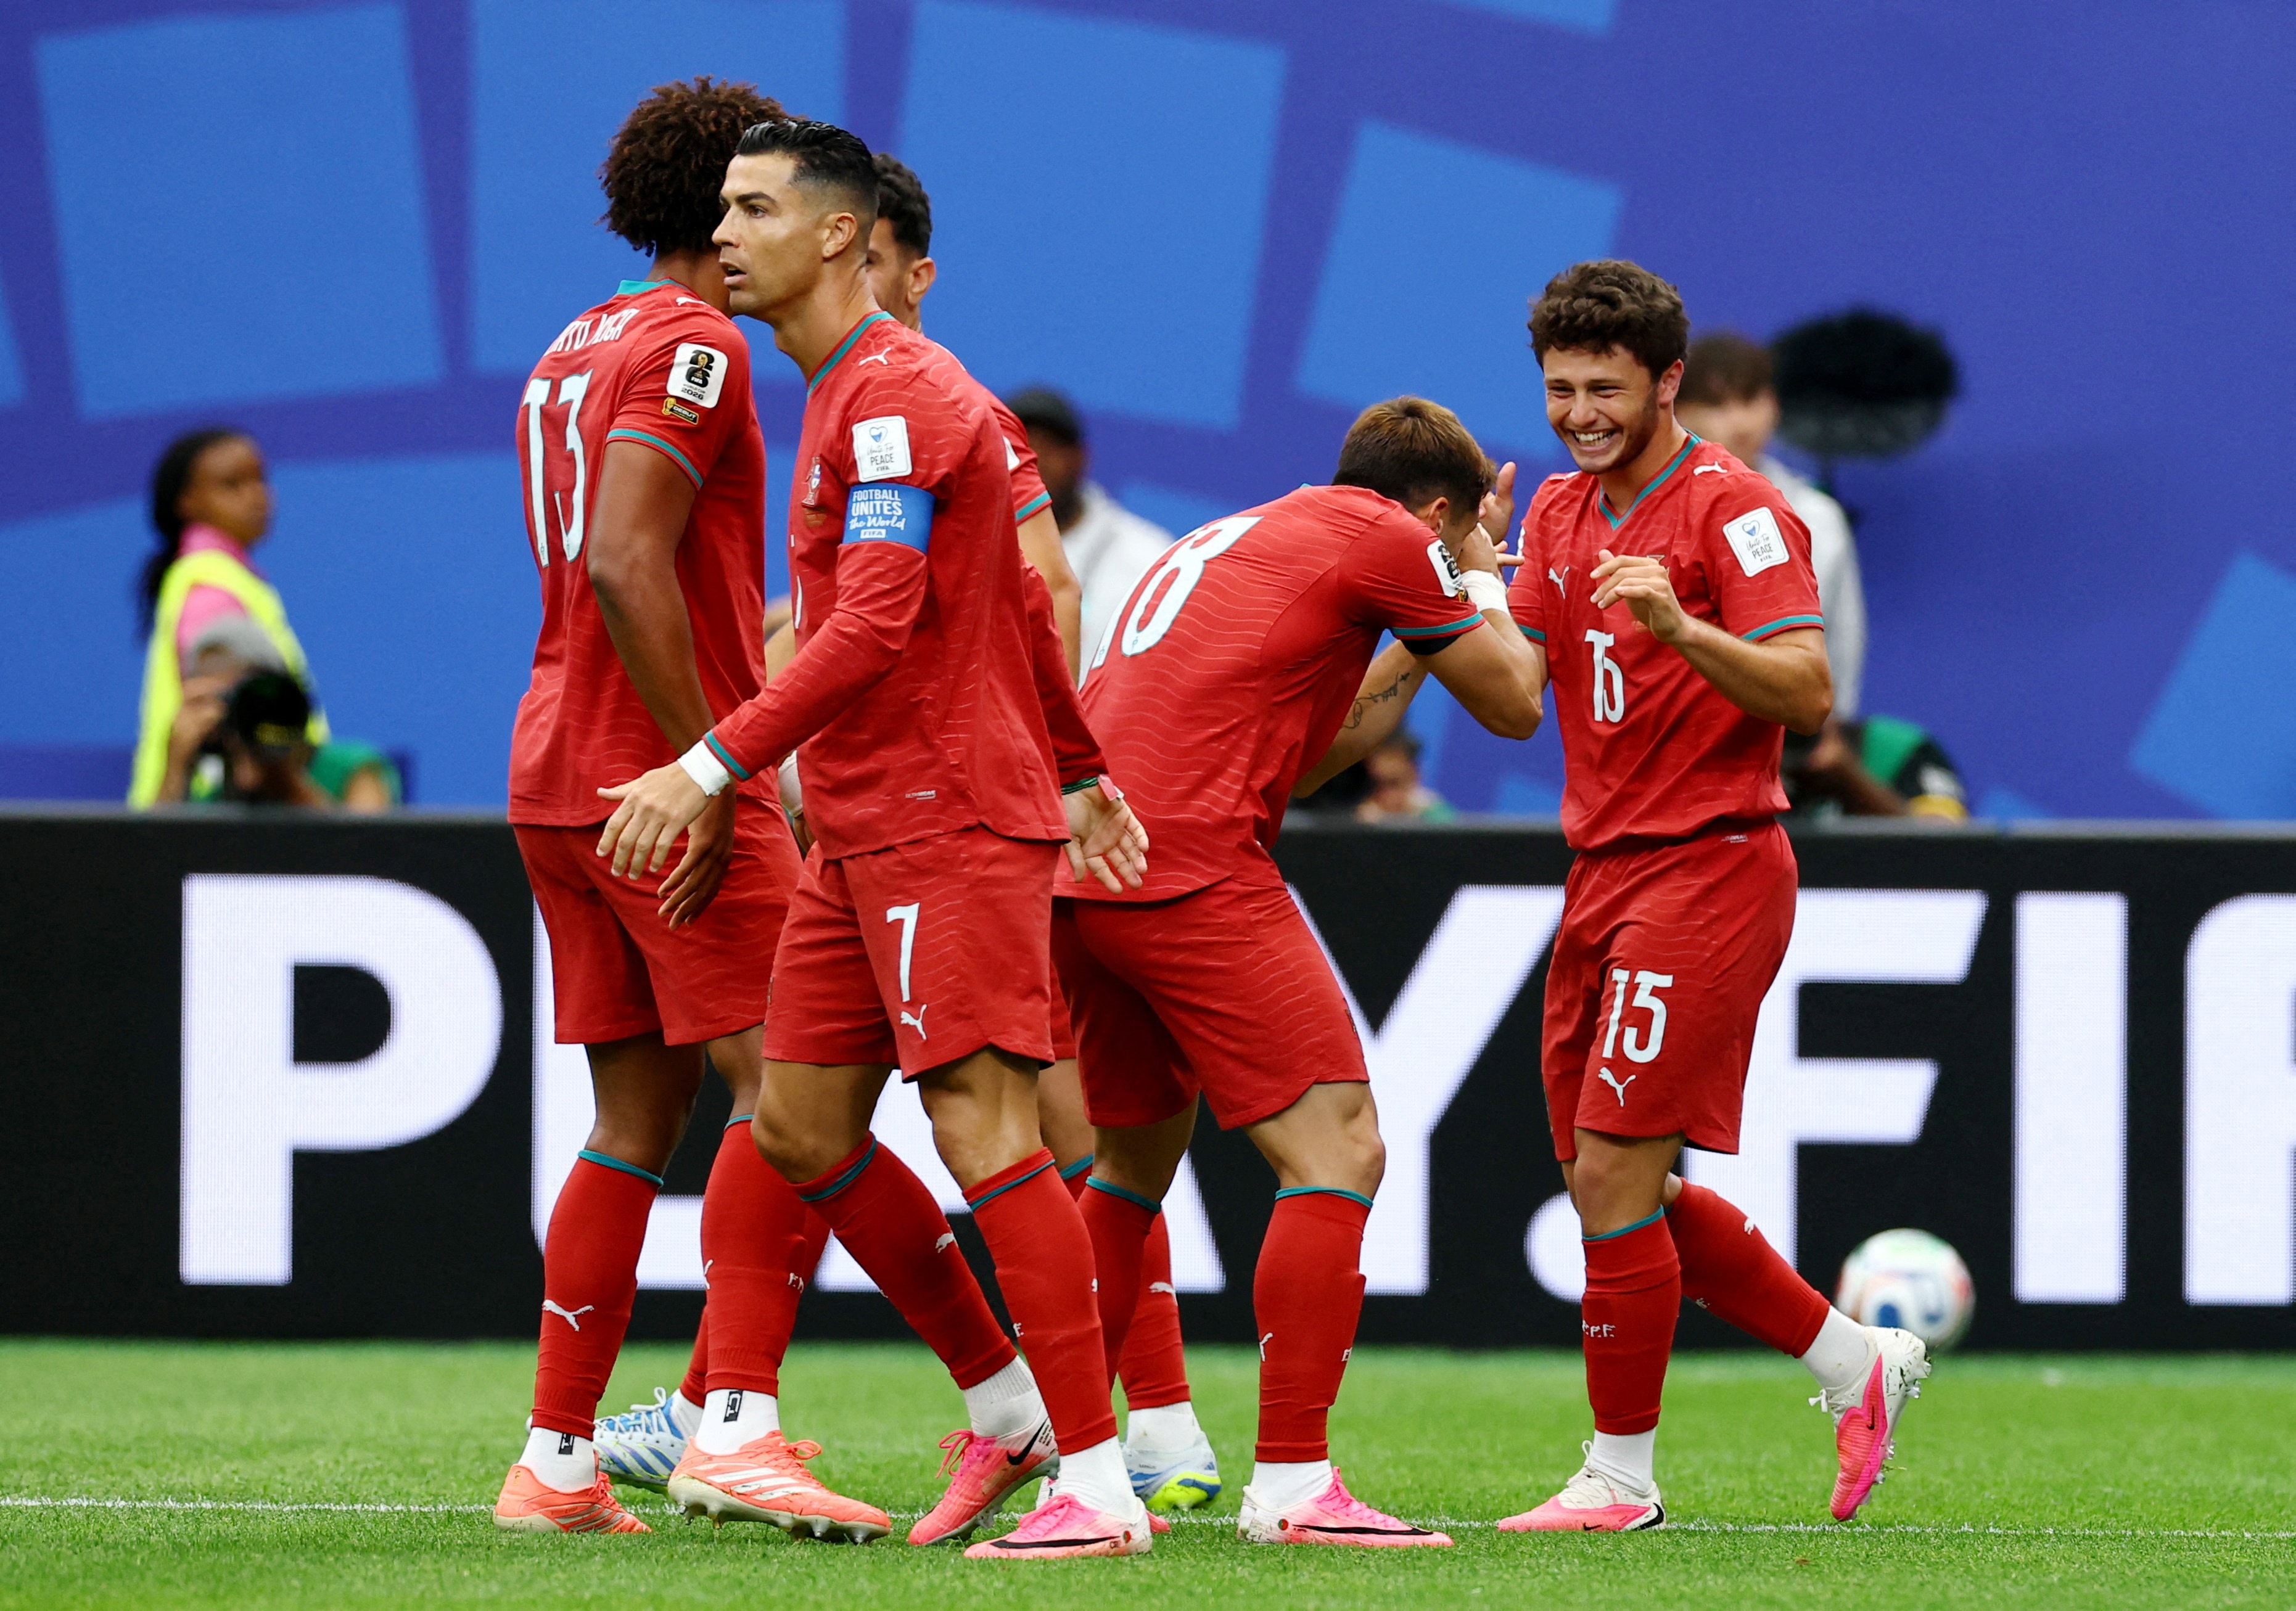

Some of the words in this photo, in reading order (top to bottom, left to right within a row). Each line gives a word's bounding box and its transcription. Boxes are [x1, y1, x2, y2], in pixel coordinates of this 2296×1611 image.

[681, 387, 704, 400] 2026
[870, 453, 895, 466] PEACE
[522, 368, 594, 568] 13
[852, 489, 902, 502] FOOTBALL
[851, 500, 903, 517] UNITES
[849, 517, 866, 530] the
[865, 515, 907, 531] World
[1751, 543, 1774, 559] PEACE
[1584, 629, 1625, 723] 15
[886, 902, 920, 1003] 7
[1602, 968, 1674, 1064] 15
